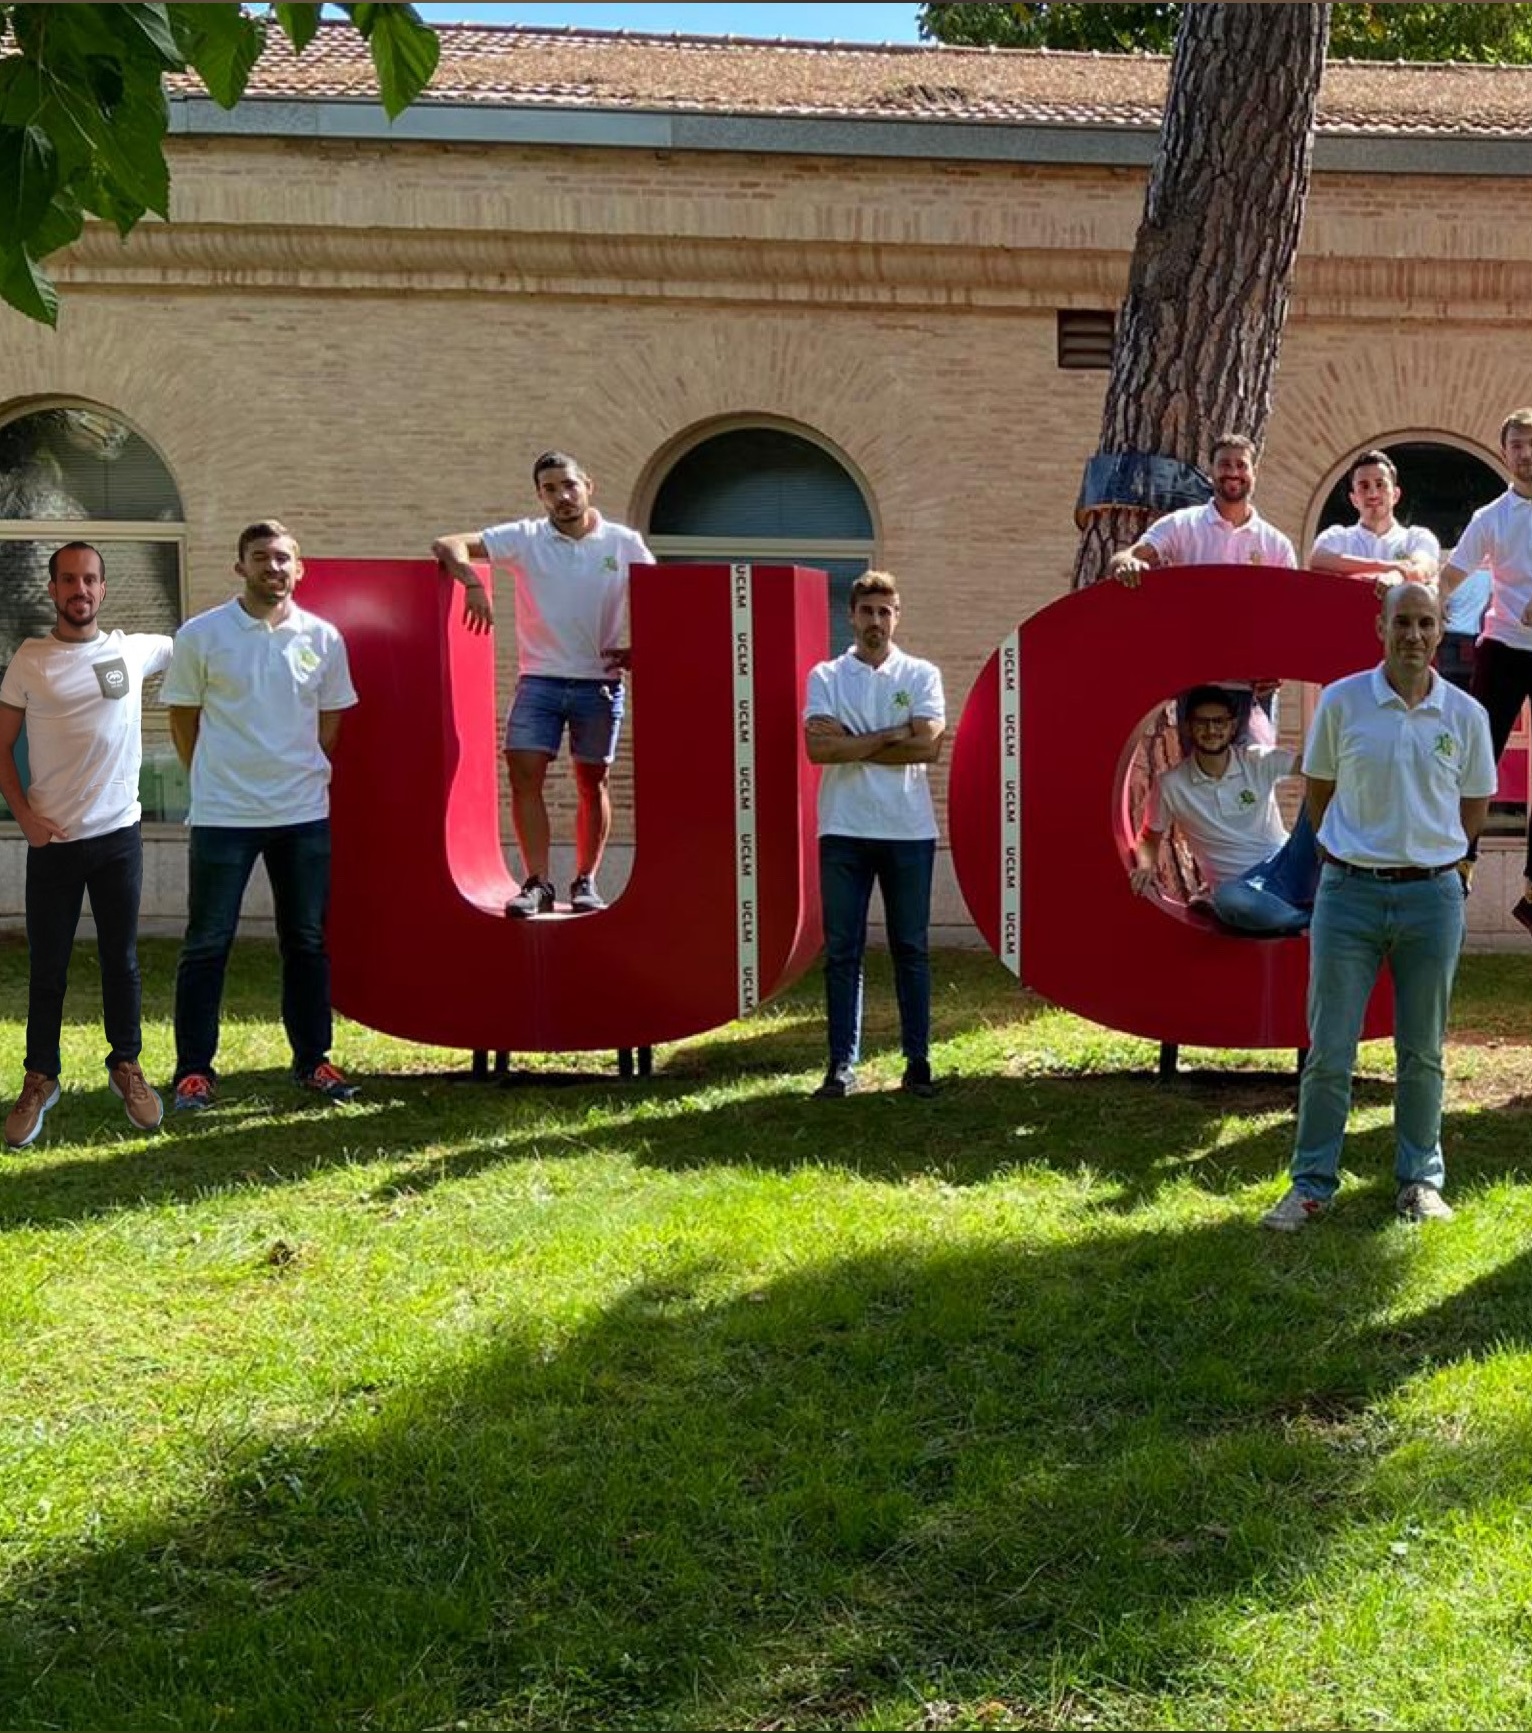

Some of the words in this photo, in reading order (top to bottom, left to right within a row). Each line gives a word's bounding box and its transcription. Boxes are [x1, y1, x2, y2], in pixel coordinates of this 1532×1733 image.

[736, 565, 746, 608] UCLM
[738, 633, 748, 676] UCLM
[1005, 647, 1015, 691] UCLM
[739, 700, 749, 742] UCLM
[1005, 714, 1015, 757] UCLM
[740, 767, 750, 810] UCLM
[1006, 780, 1016, 823] UCLM
[740, 834, 751, 876] UCLM
[1007, 847, 1016, 889] UCLM
[742, 900, 753, 943] UCLM
[1007, 912, 1016, 955] UCLM
